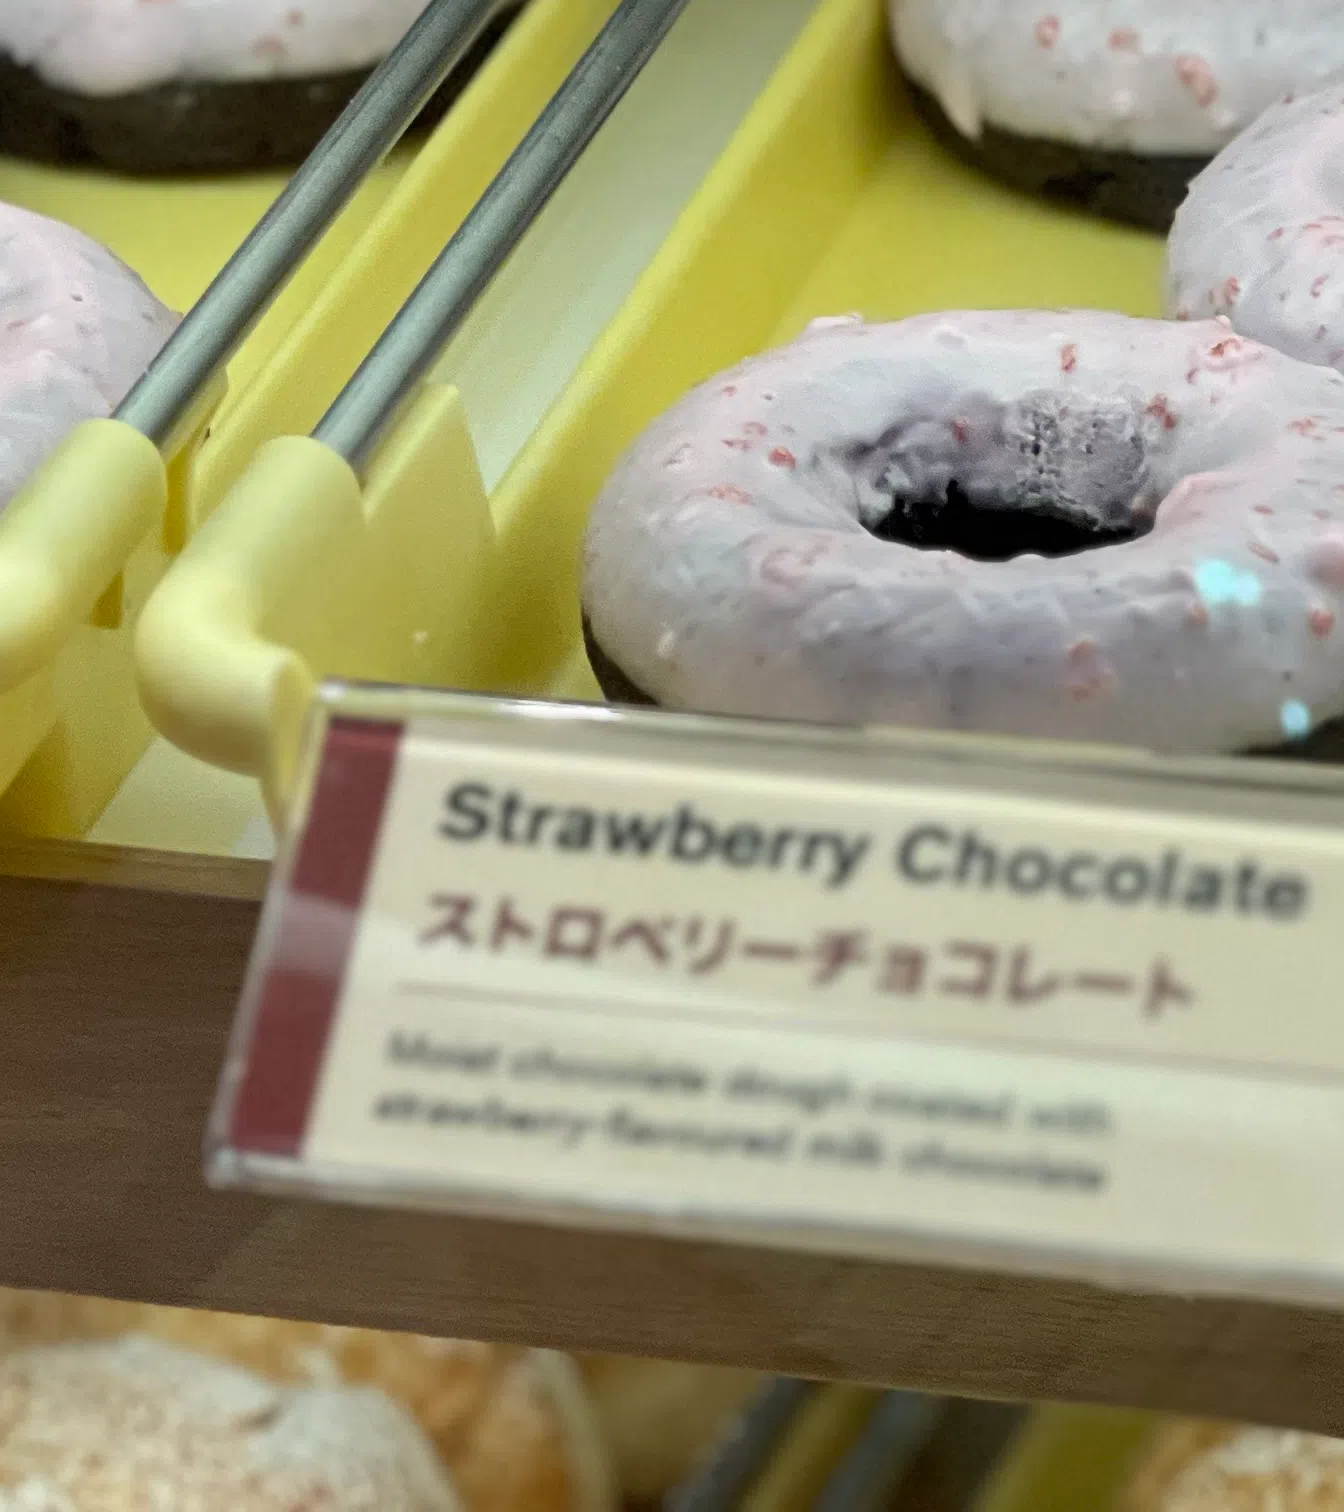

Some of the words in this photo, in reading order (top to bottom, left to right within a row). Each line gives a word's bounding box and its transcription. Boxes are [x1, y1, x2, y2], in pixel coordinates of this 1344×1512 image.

[437, 781, 873, 891] Strawberry
[895, 821, 1312, 923] Chocolate
[418, 890, 1198, 1024] ストロベリーチョコレート
